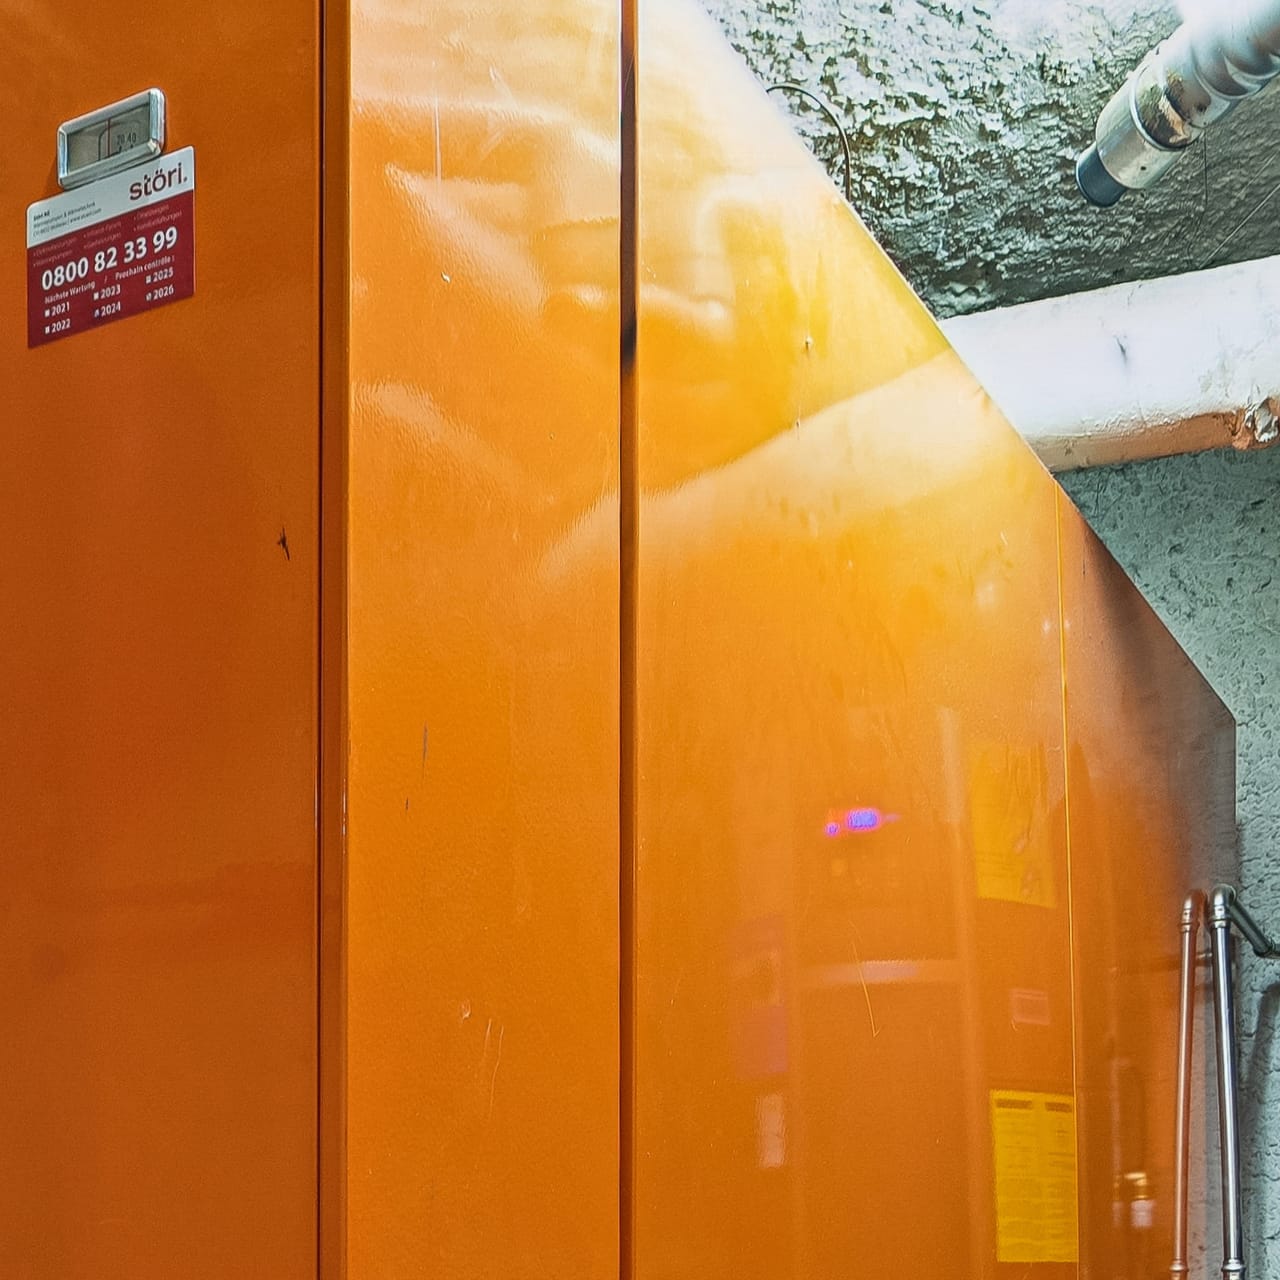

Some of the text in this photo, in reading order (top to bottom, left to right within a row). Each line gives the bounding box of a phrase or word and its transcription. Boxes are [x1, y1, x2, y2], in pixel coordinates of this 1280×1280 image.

[41, 256, 89, 291] 0800
[94, 246, 118, 274] 82
[123, 236, 148, 265] 33
[152, 226, 178, 255] 99
[153, 267, 174, 282] 2025
[44, 290, 69, 305] Nächste
[69, 280, 96, 297] Wartung
[115, 265, 144, 281] Prochain
[100, 284, 121, 300] 2023
[153, 285, 174, 300] 2026
[51, 302, 70, 317] 2021
[100, 301, 121, 317] 2024
[51, 318, 71, 334] 2022
